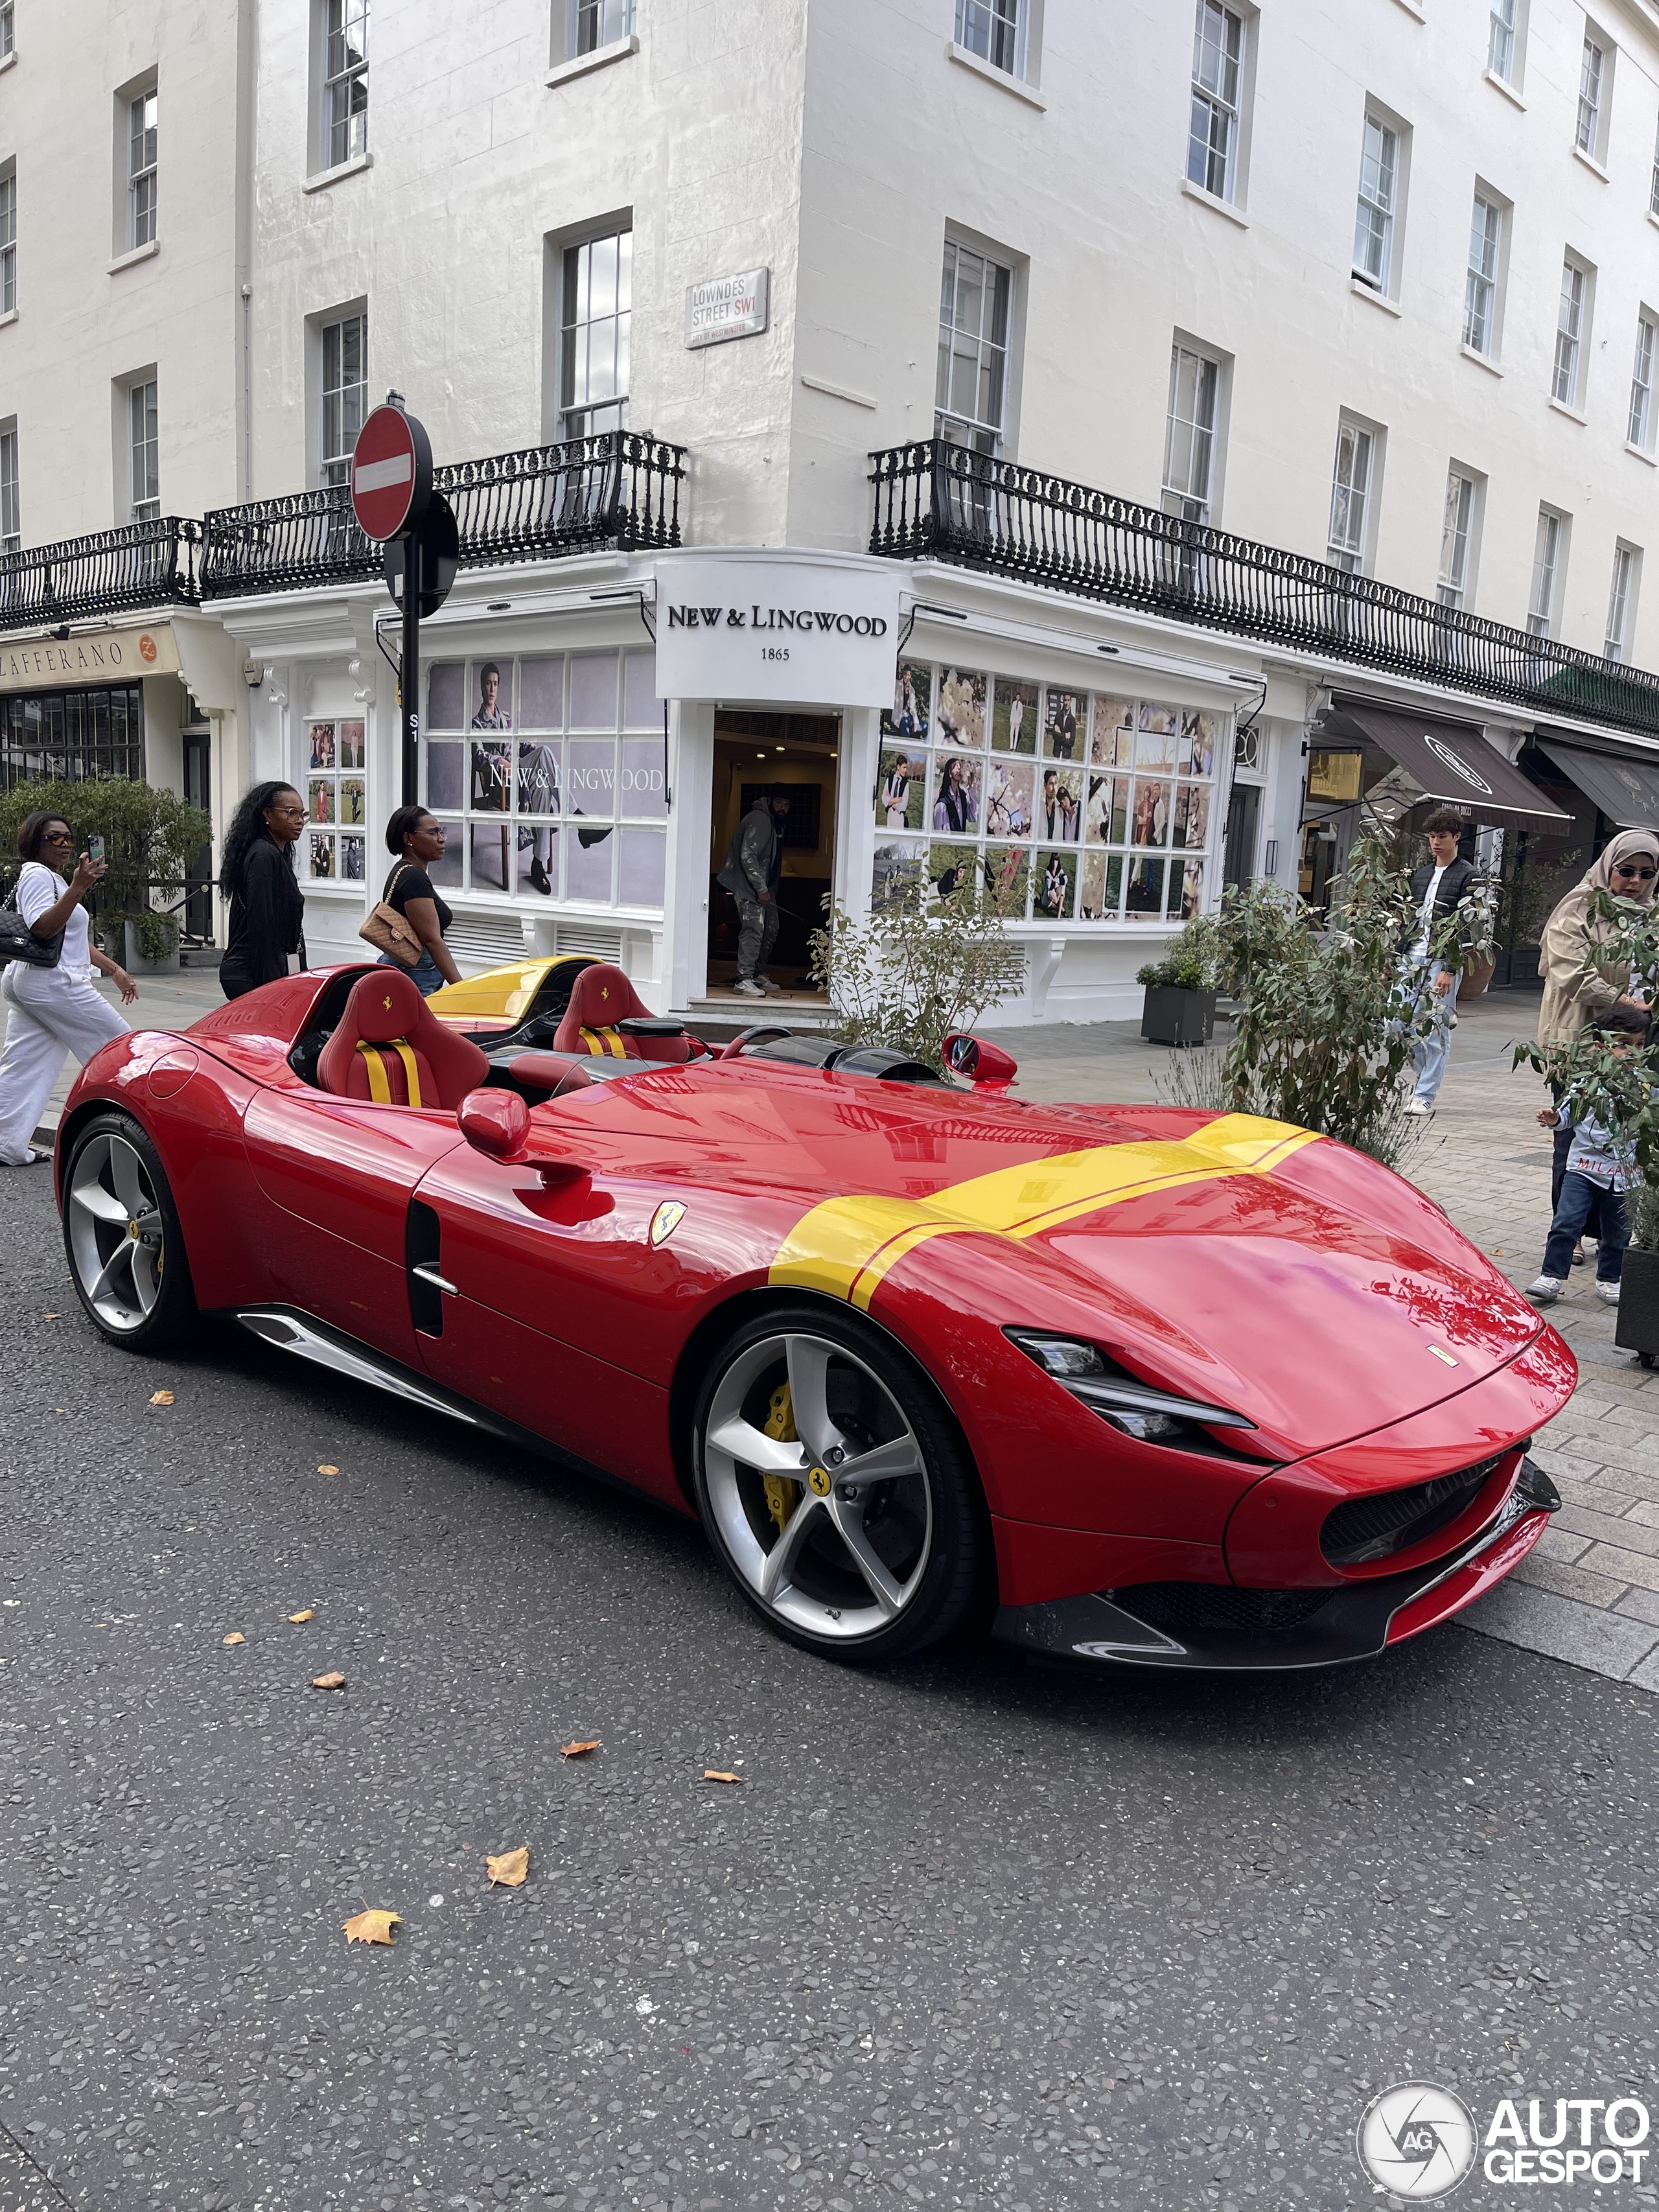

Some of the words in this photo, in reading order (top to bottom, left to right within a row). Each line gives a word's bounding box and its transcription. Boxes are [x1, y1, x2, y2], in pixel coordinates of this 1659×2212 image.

[693, 279, 745, 307] LOWNDES
[693, 302, 730, 327] STREET
[734, 296, 755, 316] SW1
[692, 334, 702, 343] CITY
[711, 323, 745, 338] WESTMINSTER
[667, 605, 723, 627] NEW
[726, 609, 745, 627] &
[750, 605, 887, 636] LINGWOOD
[761, 647, 789, 660] 1865
[535, 769, 549, 789] &
